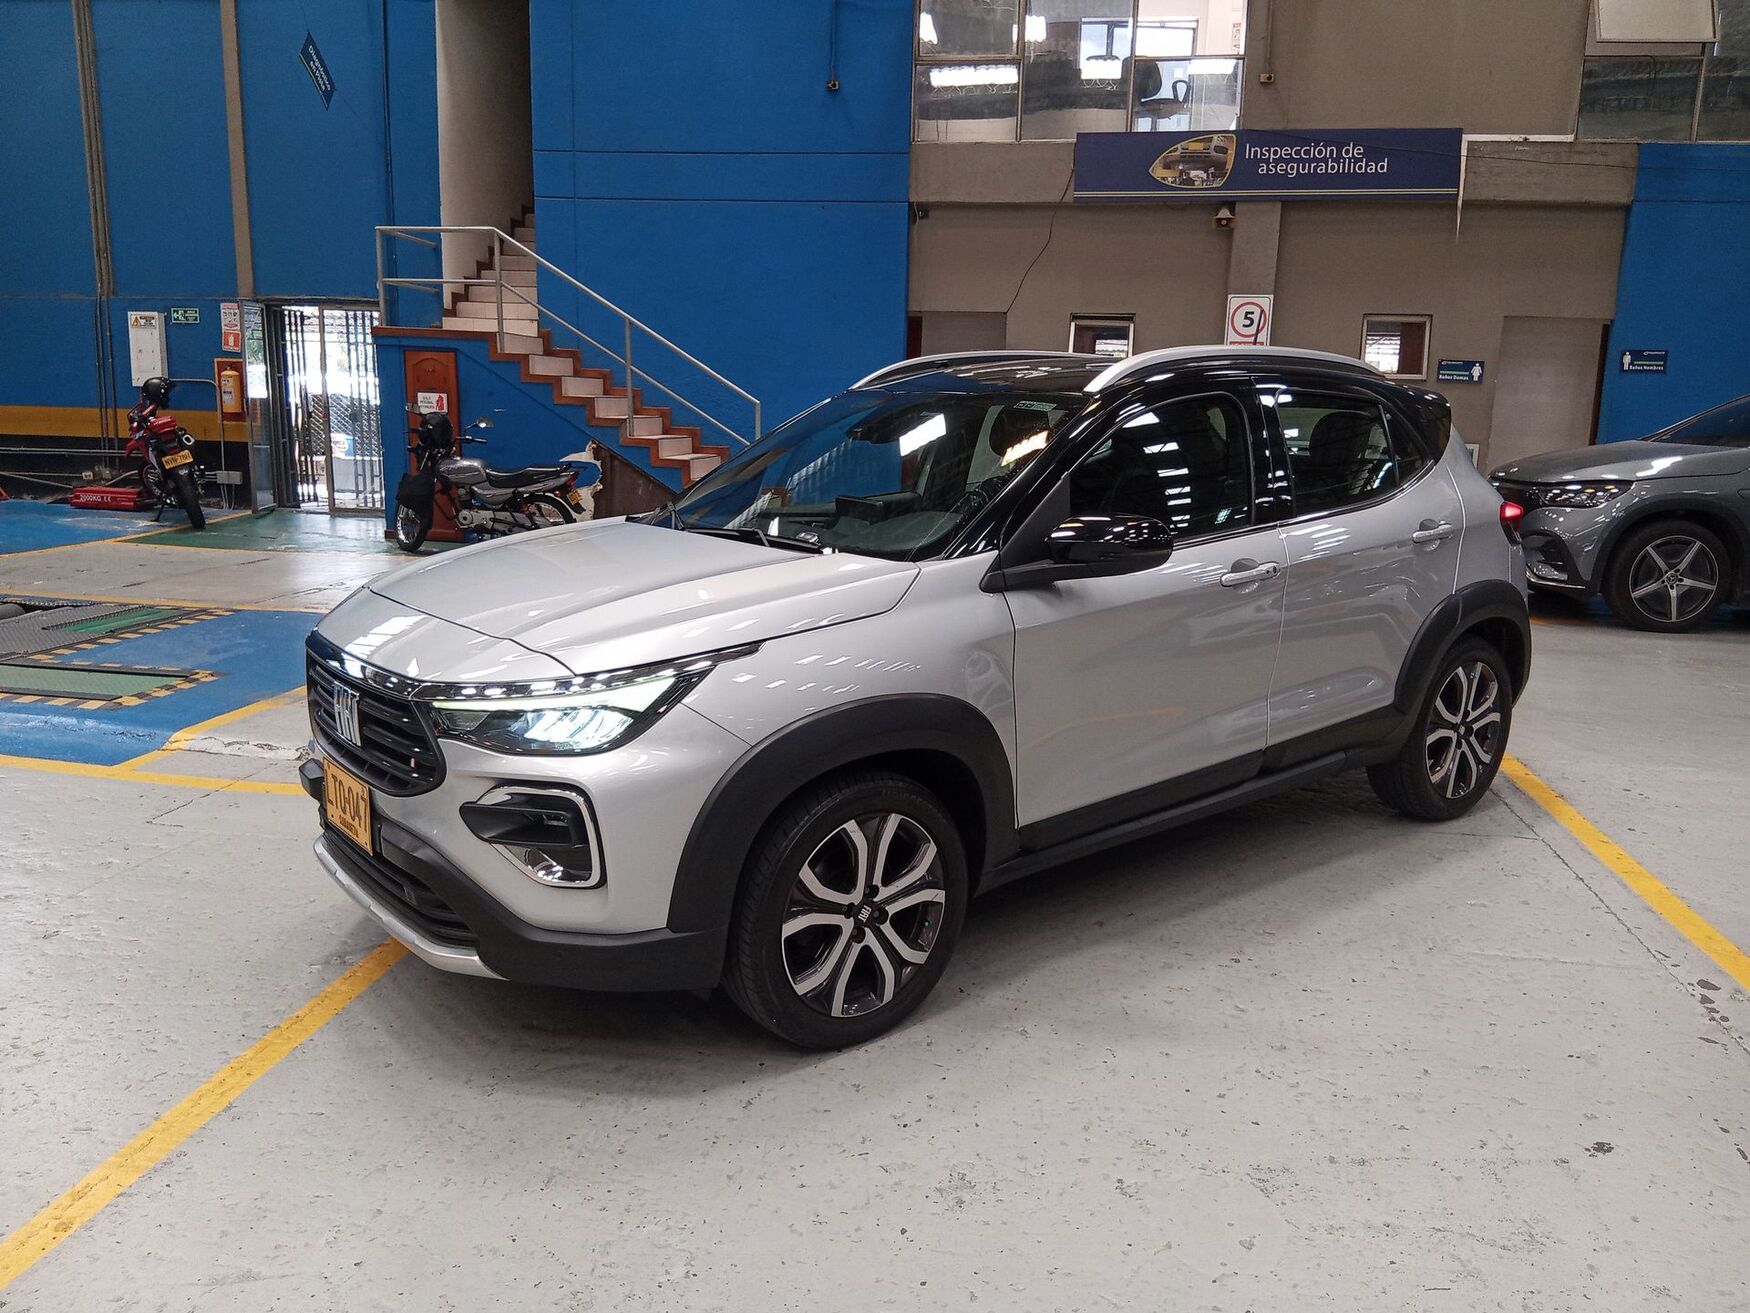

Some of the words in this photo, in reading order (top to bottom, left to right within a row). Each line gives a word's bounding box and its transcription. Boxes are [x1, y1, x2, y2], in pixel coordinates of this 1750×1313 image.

[1245, 142, 1337, 162] Inspección
[1341, 141, 1364, 158] de
[1258, 158, 1388, 178] asegurabilidad
[1242, 311, 1255, 328] 5
[858, 904, 872, 923] FIAT
